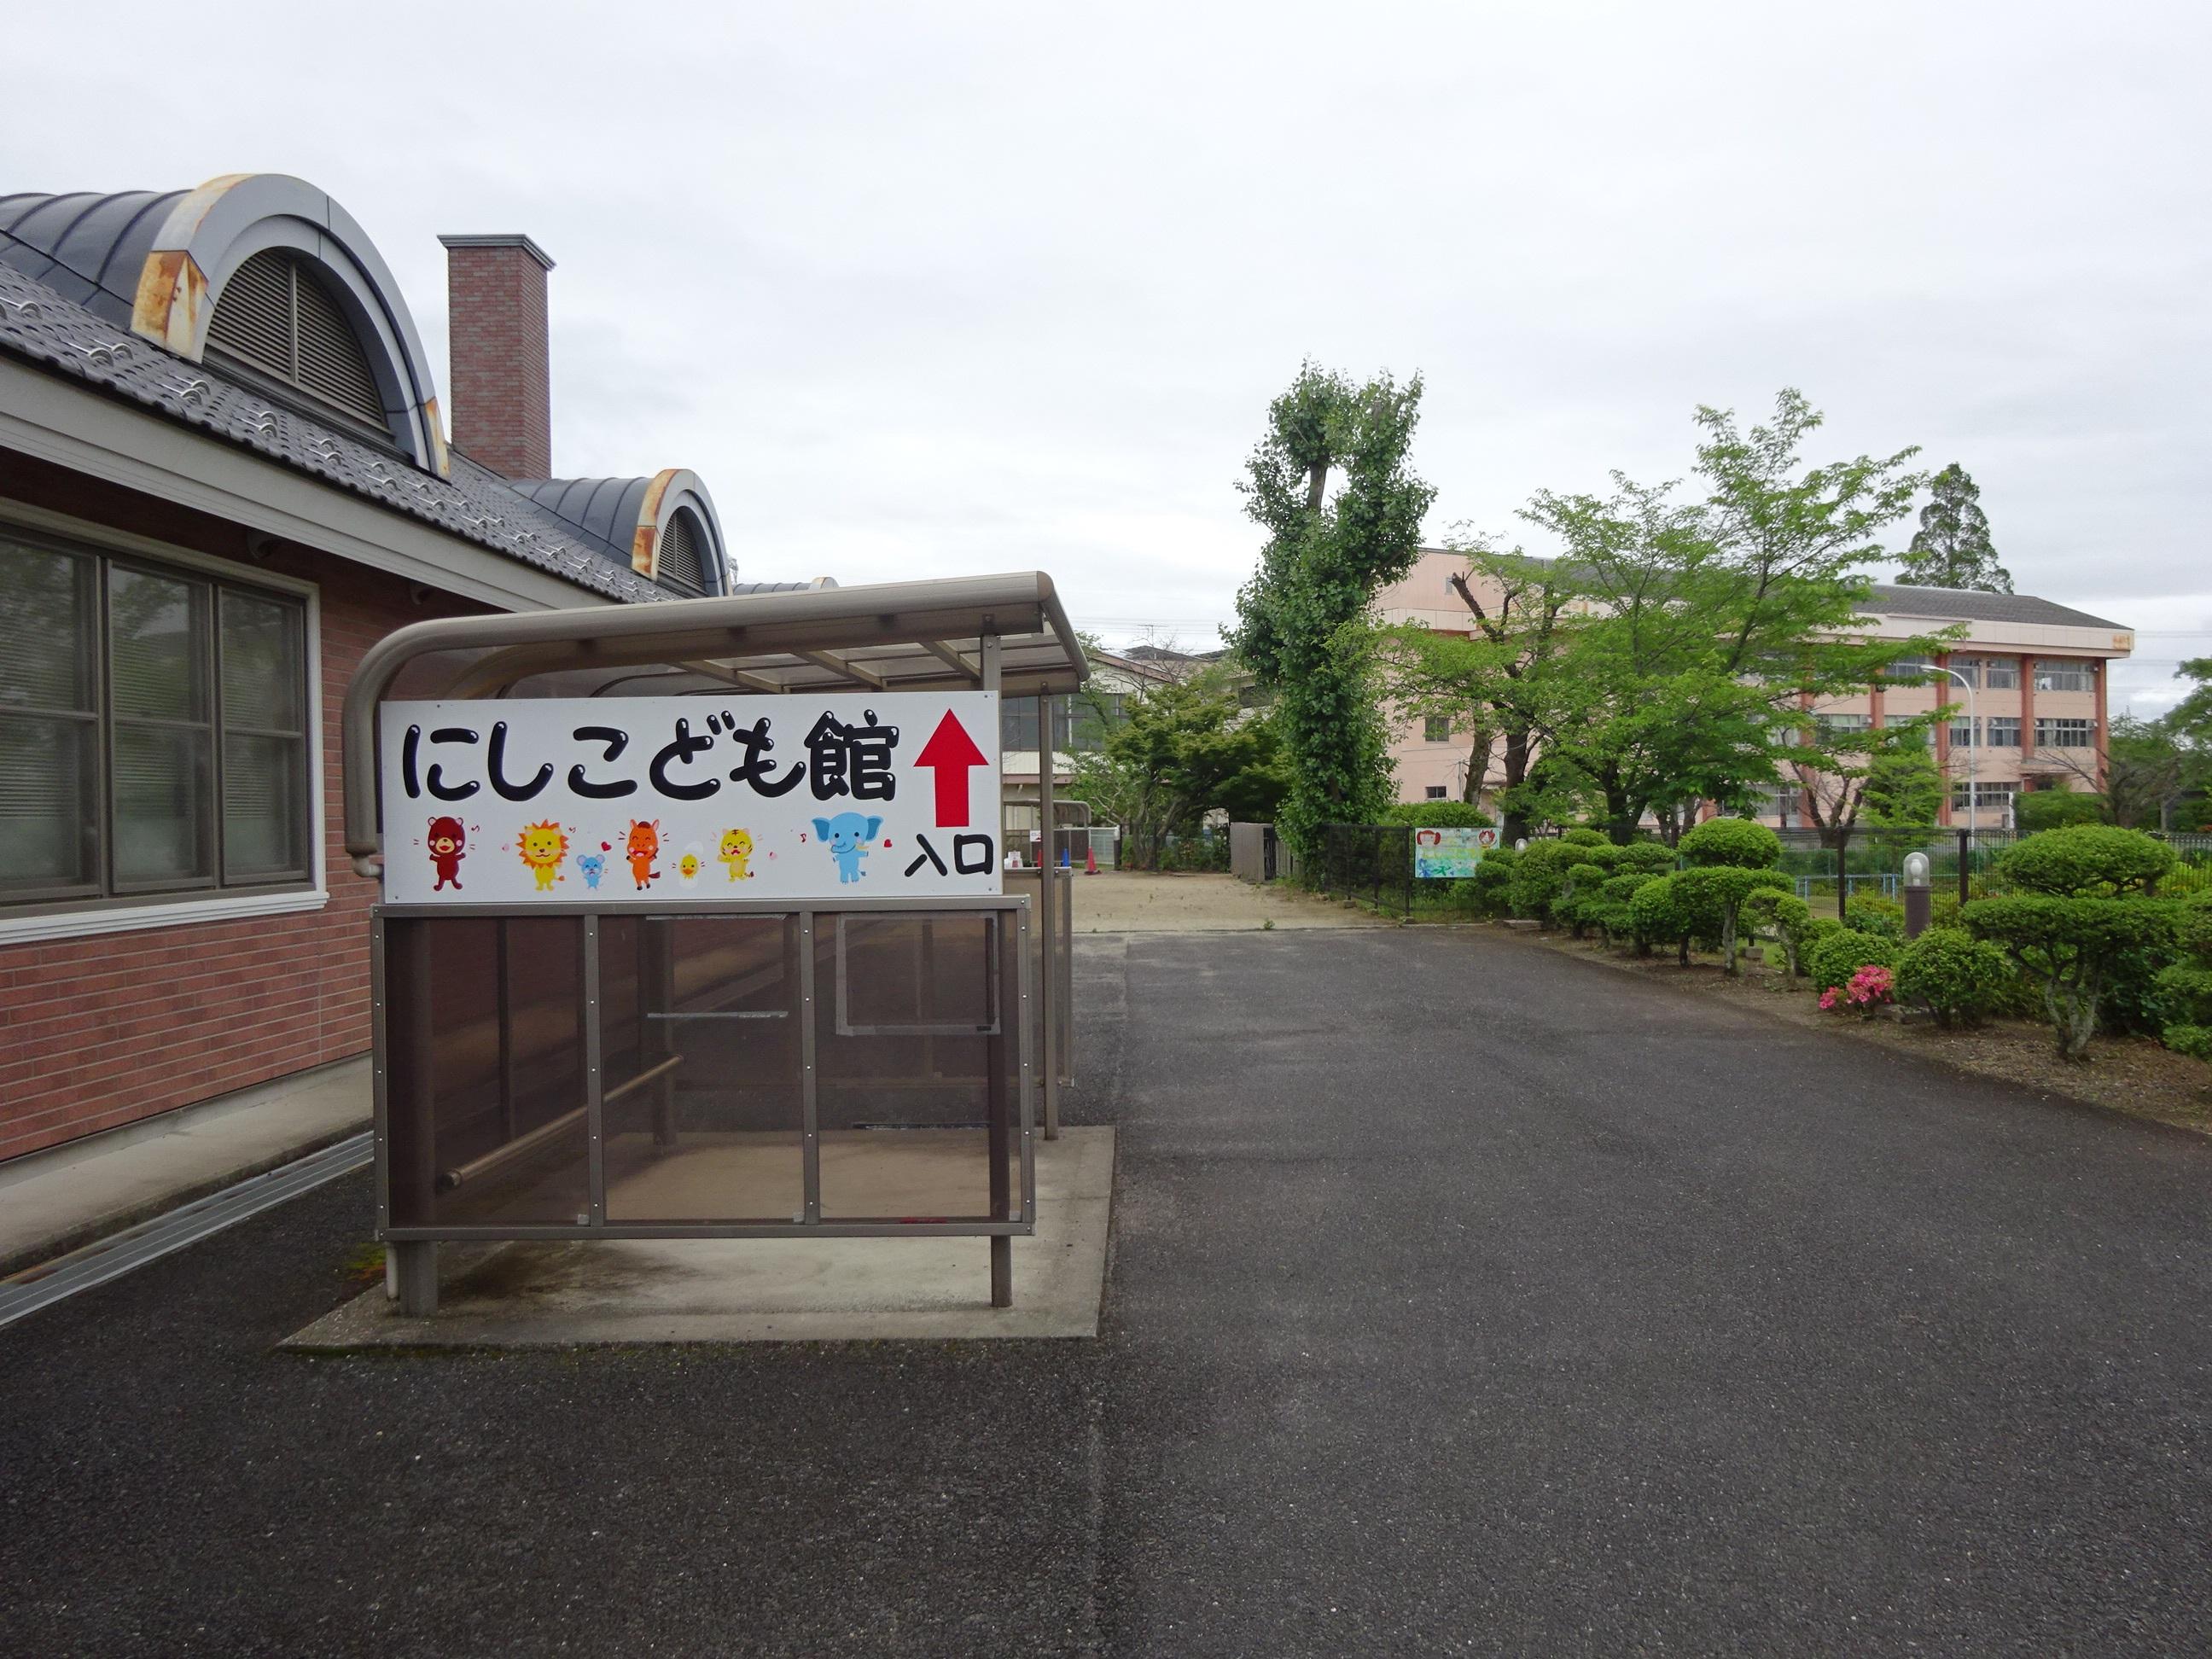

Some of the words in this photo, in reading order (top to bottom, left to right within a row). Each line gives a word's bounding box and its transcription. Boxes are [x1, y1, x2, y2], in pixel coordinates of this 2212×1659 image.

[402, 709, 899, 801] にしこども館
[904, 833, 993, 876] 入口
